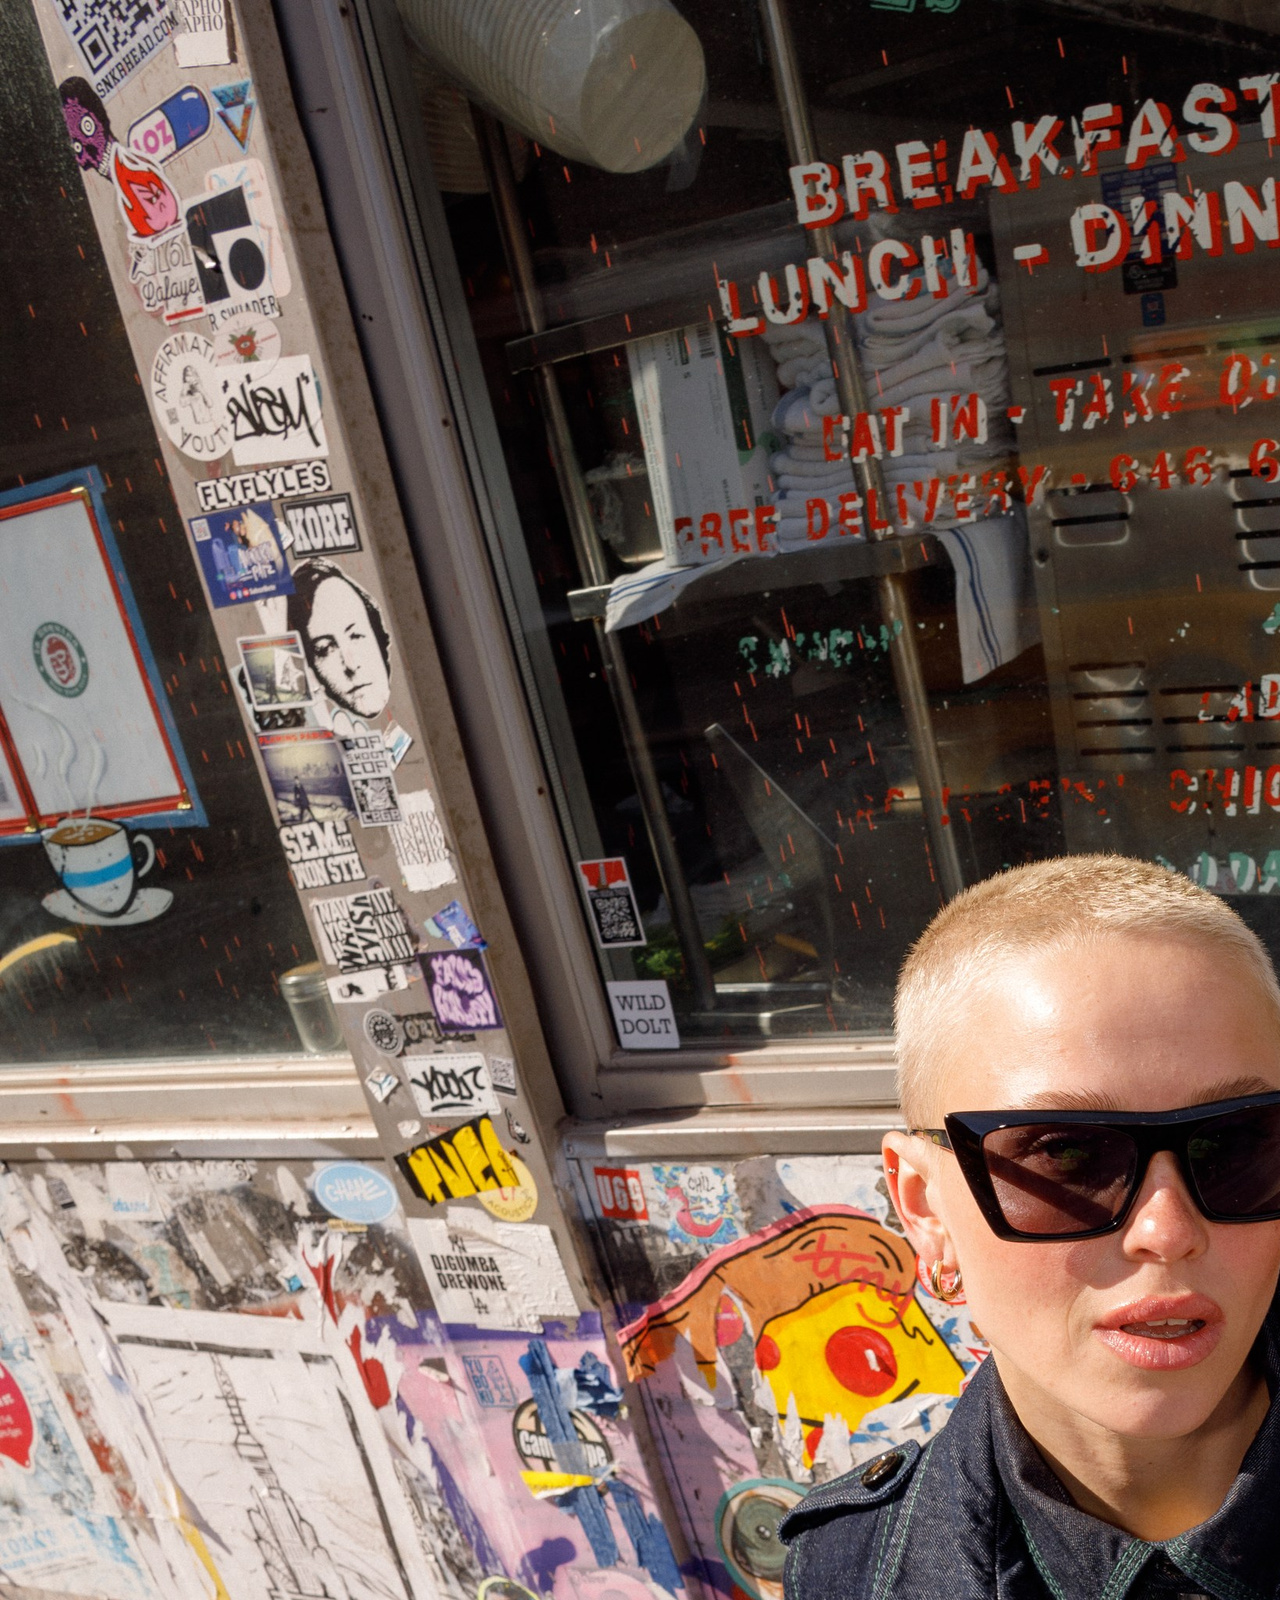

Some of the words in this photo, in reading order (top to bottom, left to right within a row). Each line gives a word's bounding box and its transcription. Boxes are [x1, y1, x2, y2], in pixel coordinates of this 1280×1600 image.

[718, 228, 978, 337] LUNCH
[823, 405, 910, 463] EAT
[930, 393, 988, 448] IN
[1049, 362, 1191, 431] TAKE
[1109, 445, 1219, 493] 646
[286, 502, 357, 552] KORE
[350, 760, 388, 775] COP
[615, 995, 666, 1011] WILD
[620, 1018, 672, 1035] DOLT
[436, 1272, 508, 1292] DREWONE
